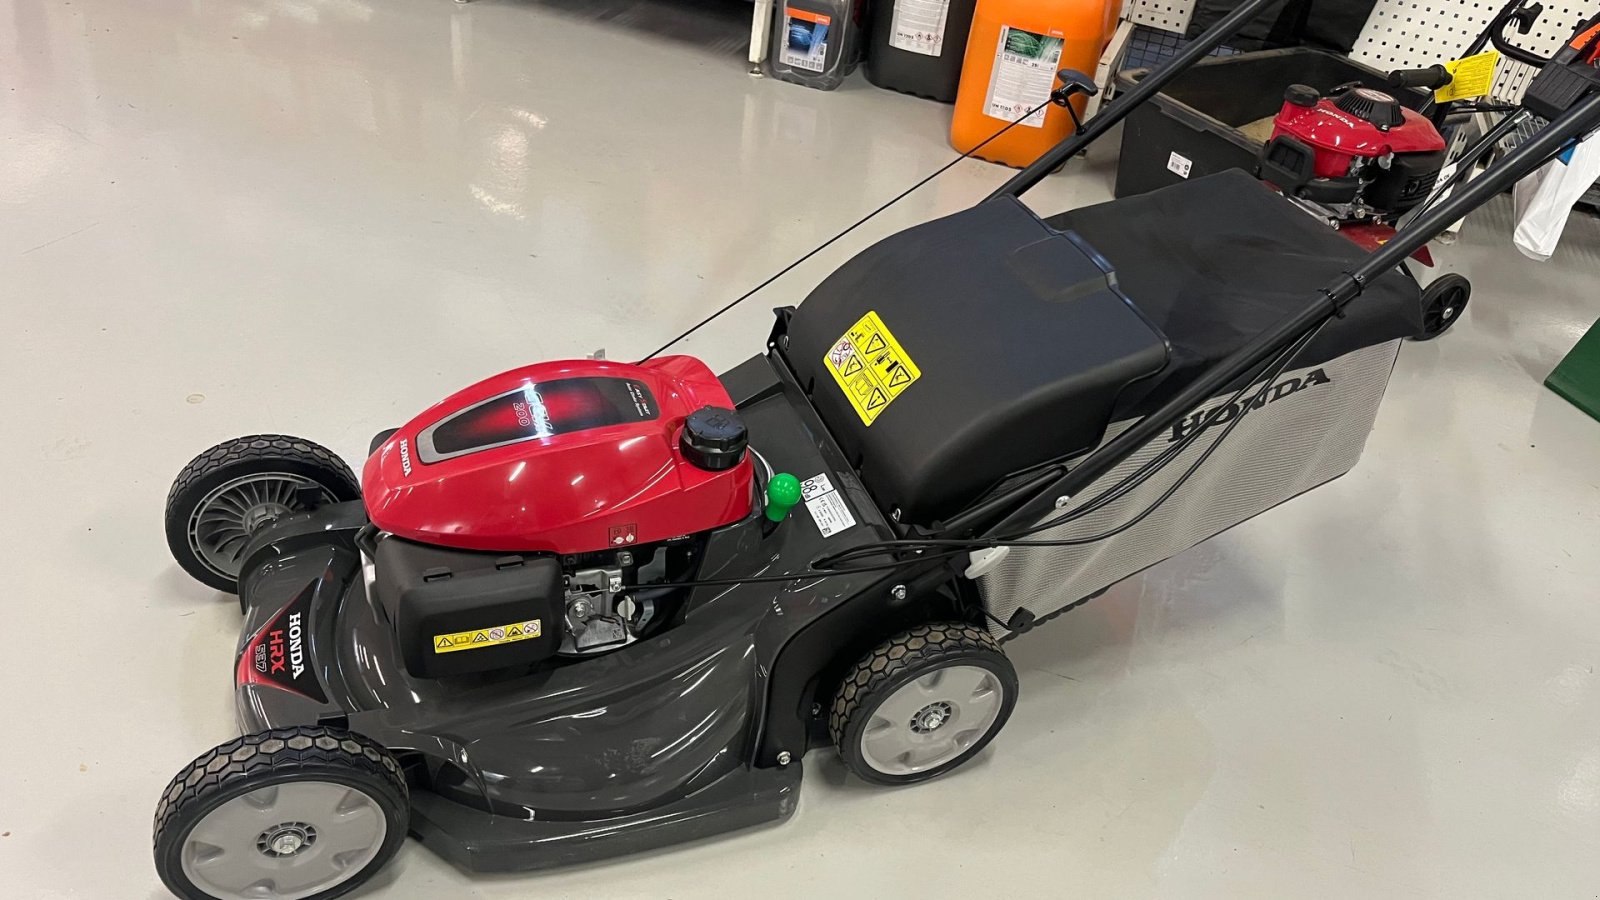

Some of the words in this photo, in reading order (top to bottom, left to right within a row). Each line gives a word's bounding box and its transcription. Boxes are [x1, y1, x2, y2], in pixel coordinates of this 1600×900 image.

[513, 402, 530, 426] 200
[1168, 368, 1330, 443] HONDA
[400, 438, 412, 477] HONDA
[255, 644, 267, 672] 537
[270, 630, 285, 674] HRX
[289, 612, 304, 680] HONDA
